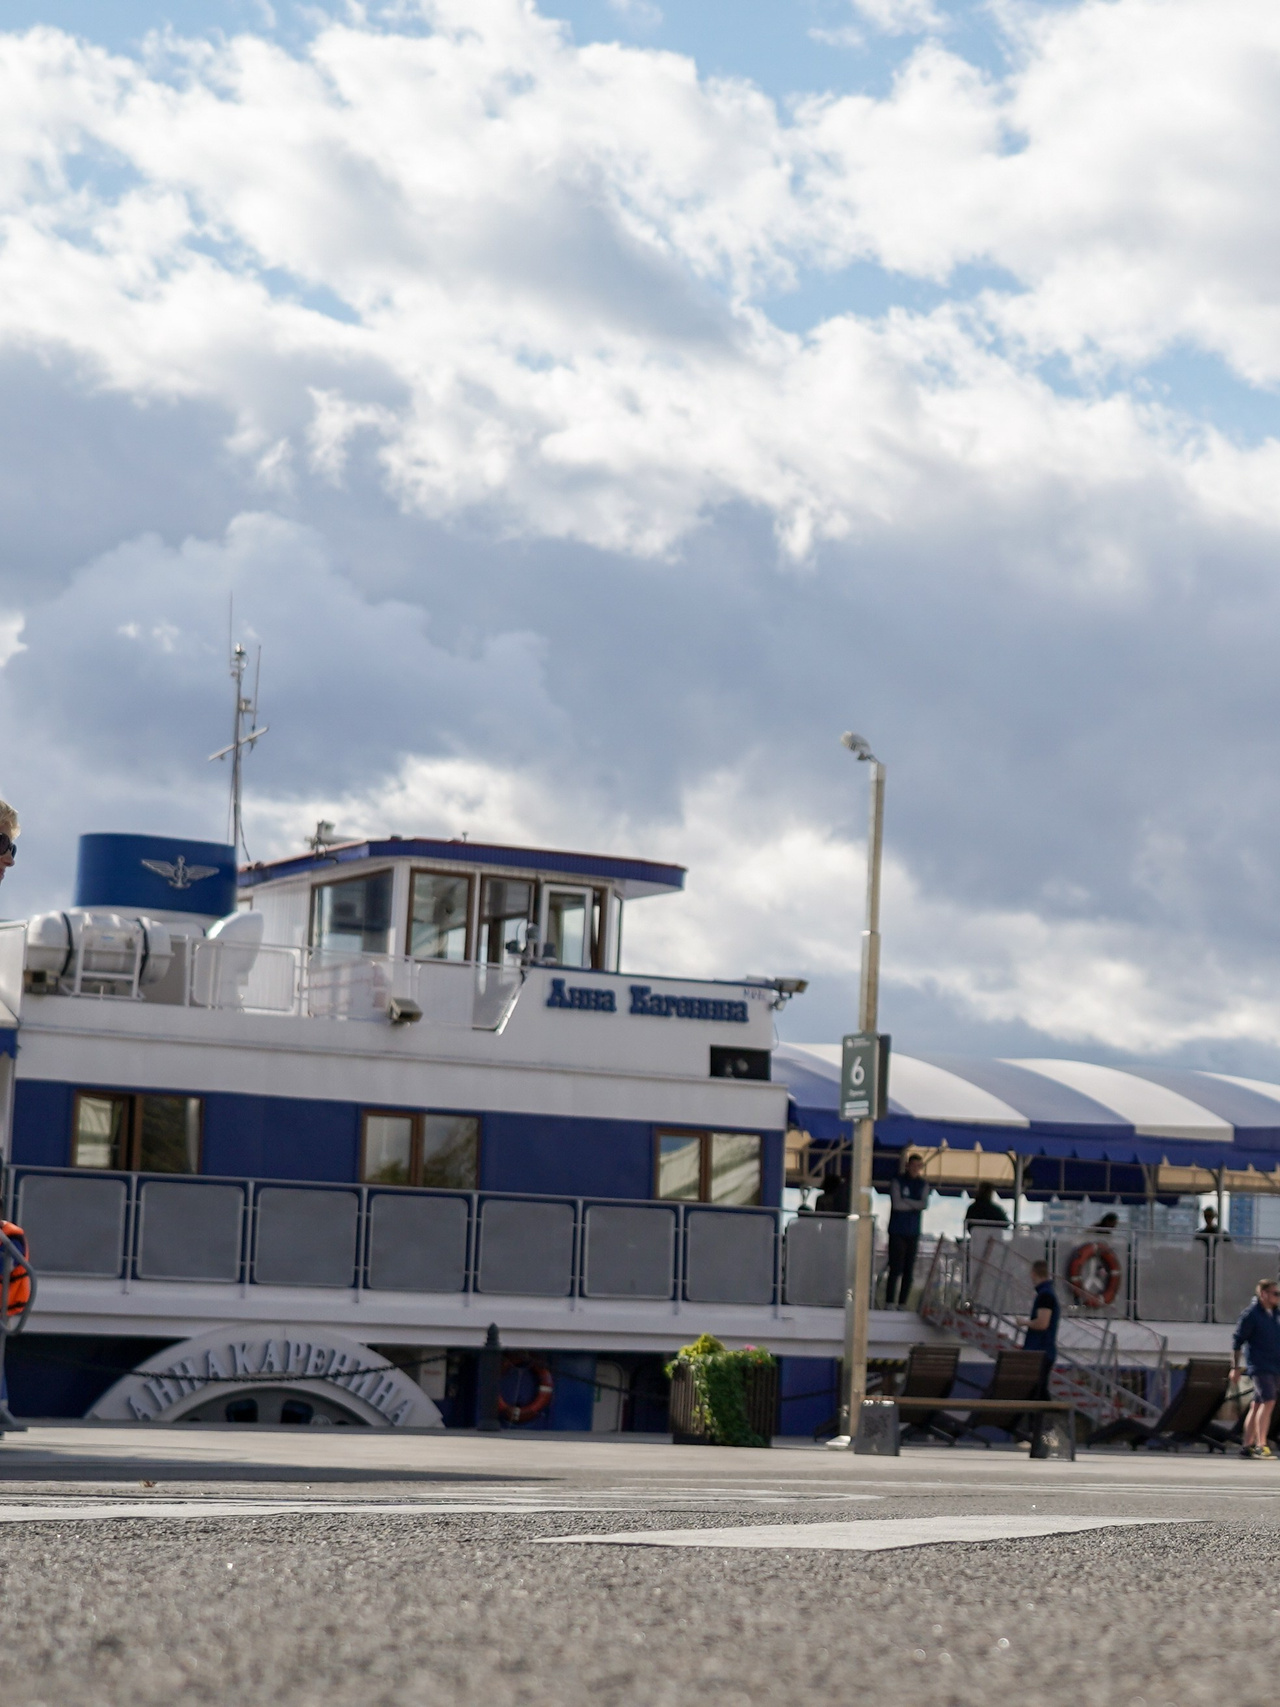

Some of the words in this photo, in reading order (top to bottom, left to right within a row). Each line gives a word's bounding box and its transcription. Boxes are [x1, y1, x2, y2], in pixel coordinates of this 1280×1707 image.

[546, 977, 617, 1013] Анна
[629, 984, 750, 1024] Каренина
[851, 1055, 865, 1086] 6
